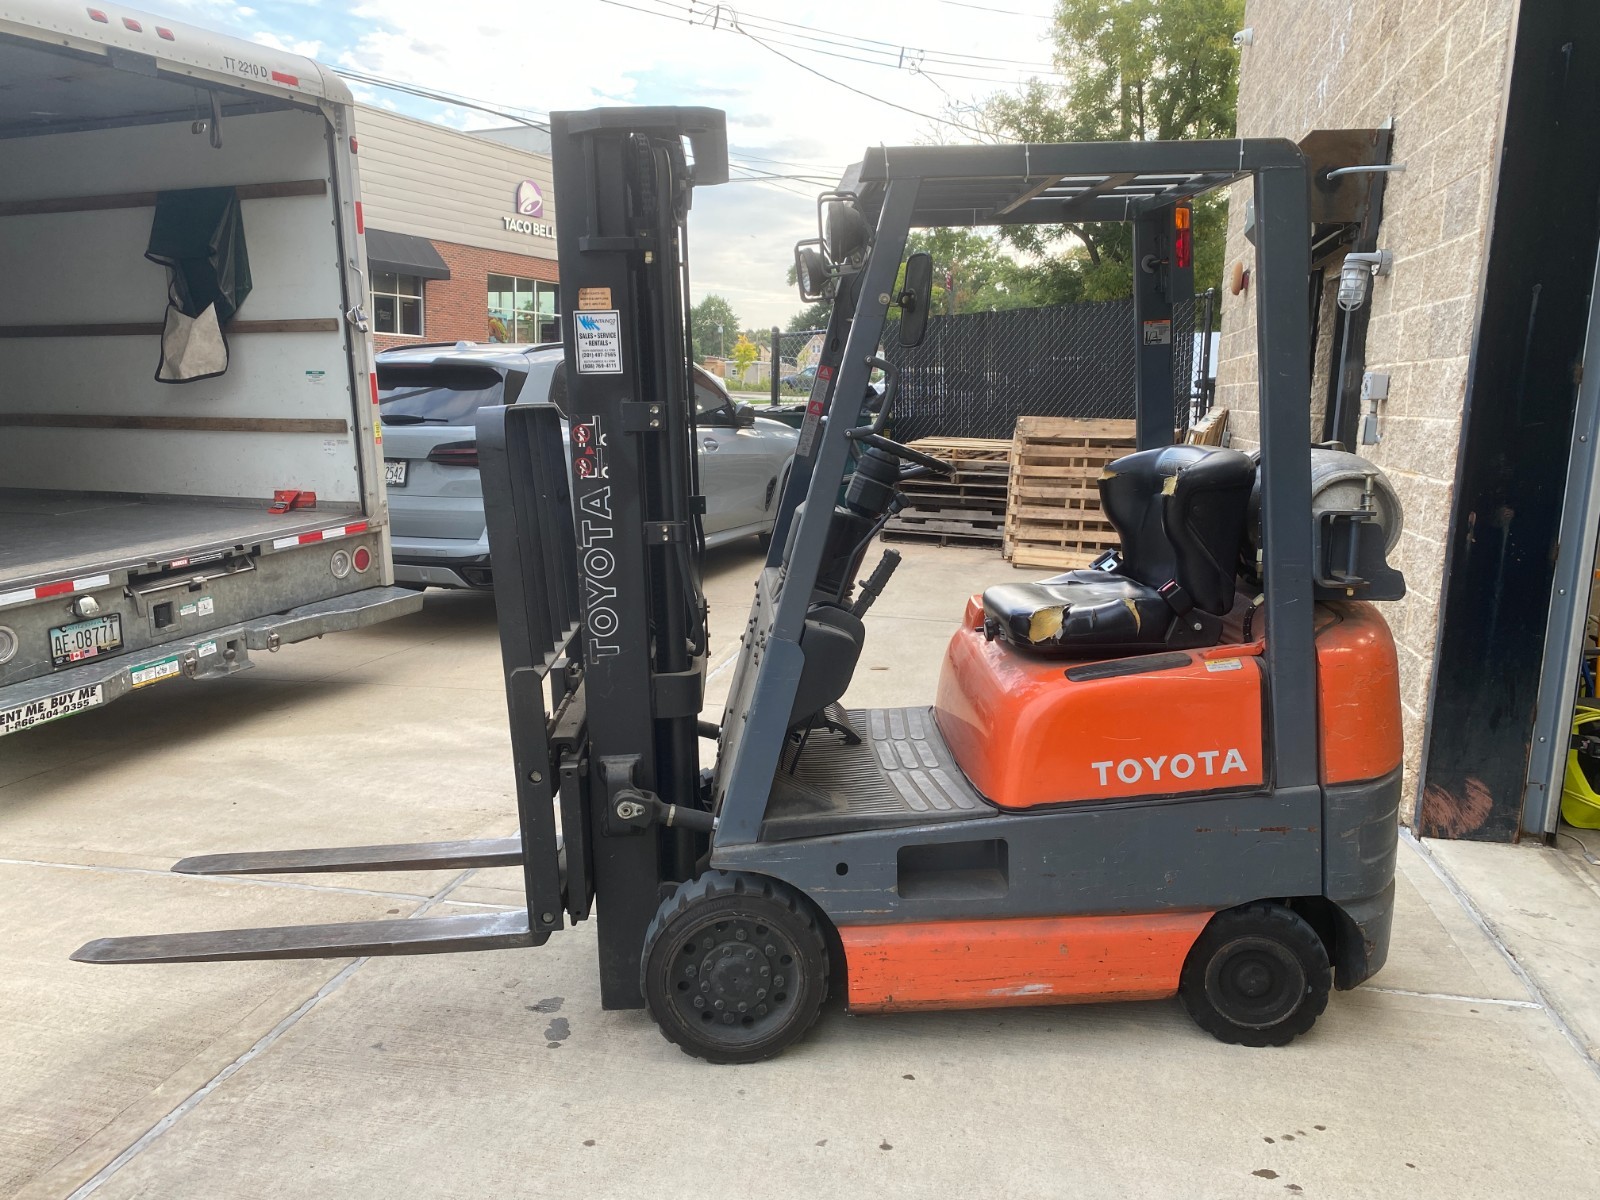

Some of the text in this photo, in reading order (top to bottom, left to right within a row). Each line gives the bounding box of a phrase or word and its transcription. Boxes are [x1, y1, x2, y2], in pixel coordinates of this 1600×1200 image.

[223, 56, 268, 77] TT 2210 D
[503, 217, 557, 239] TACO BELL
[385, 466, 403, 480] 2542
[580, 486, 620, 664] TOYOTA
[50, 693, 75, 709] BUY
[78, 687, 96, 700] ME
[1091, 748, 1248, 786] TOYOTA
